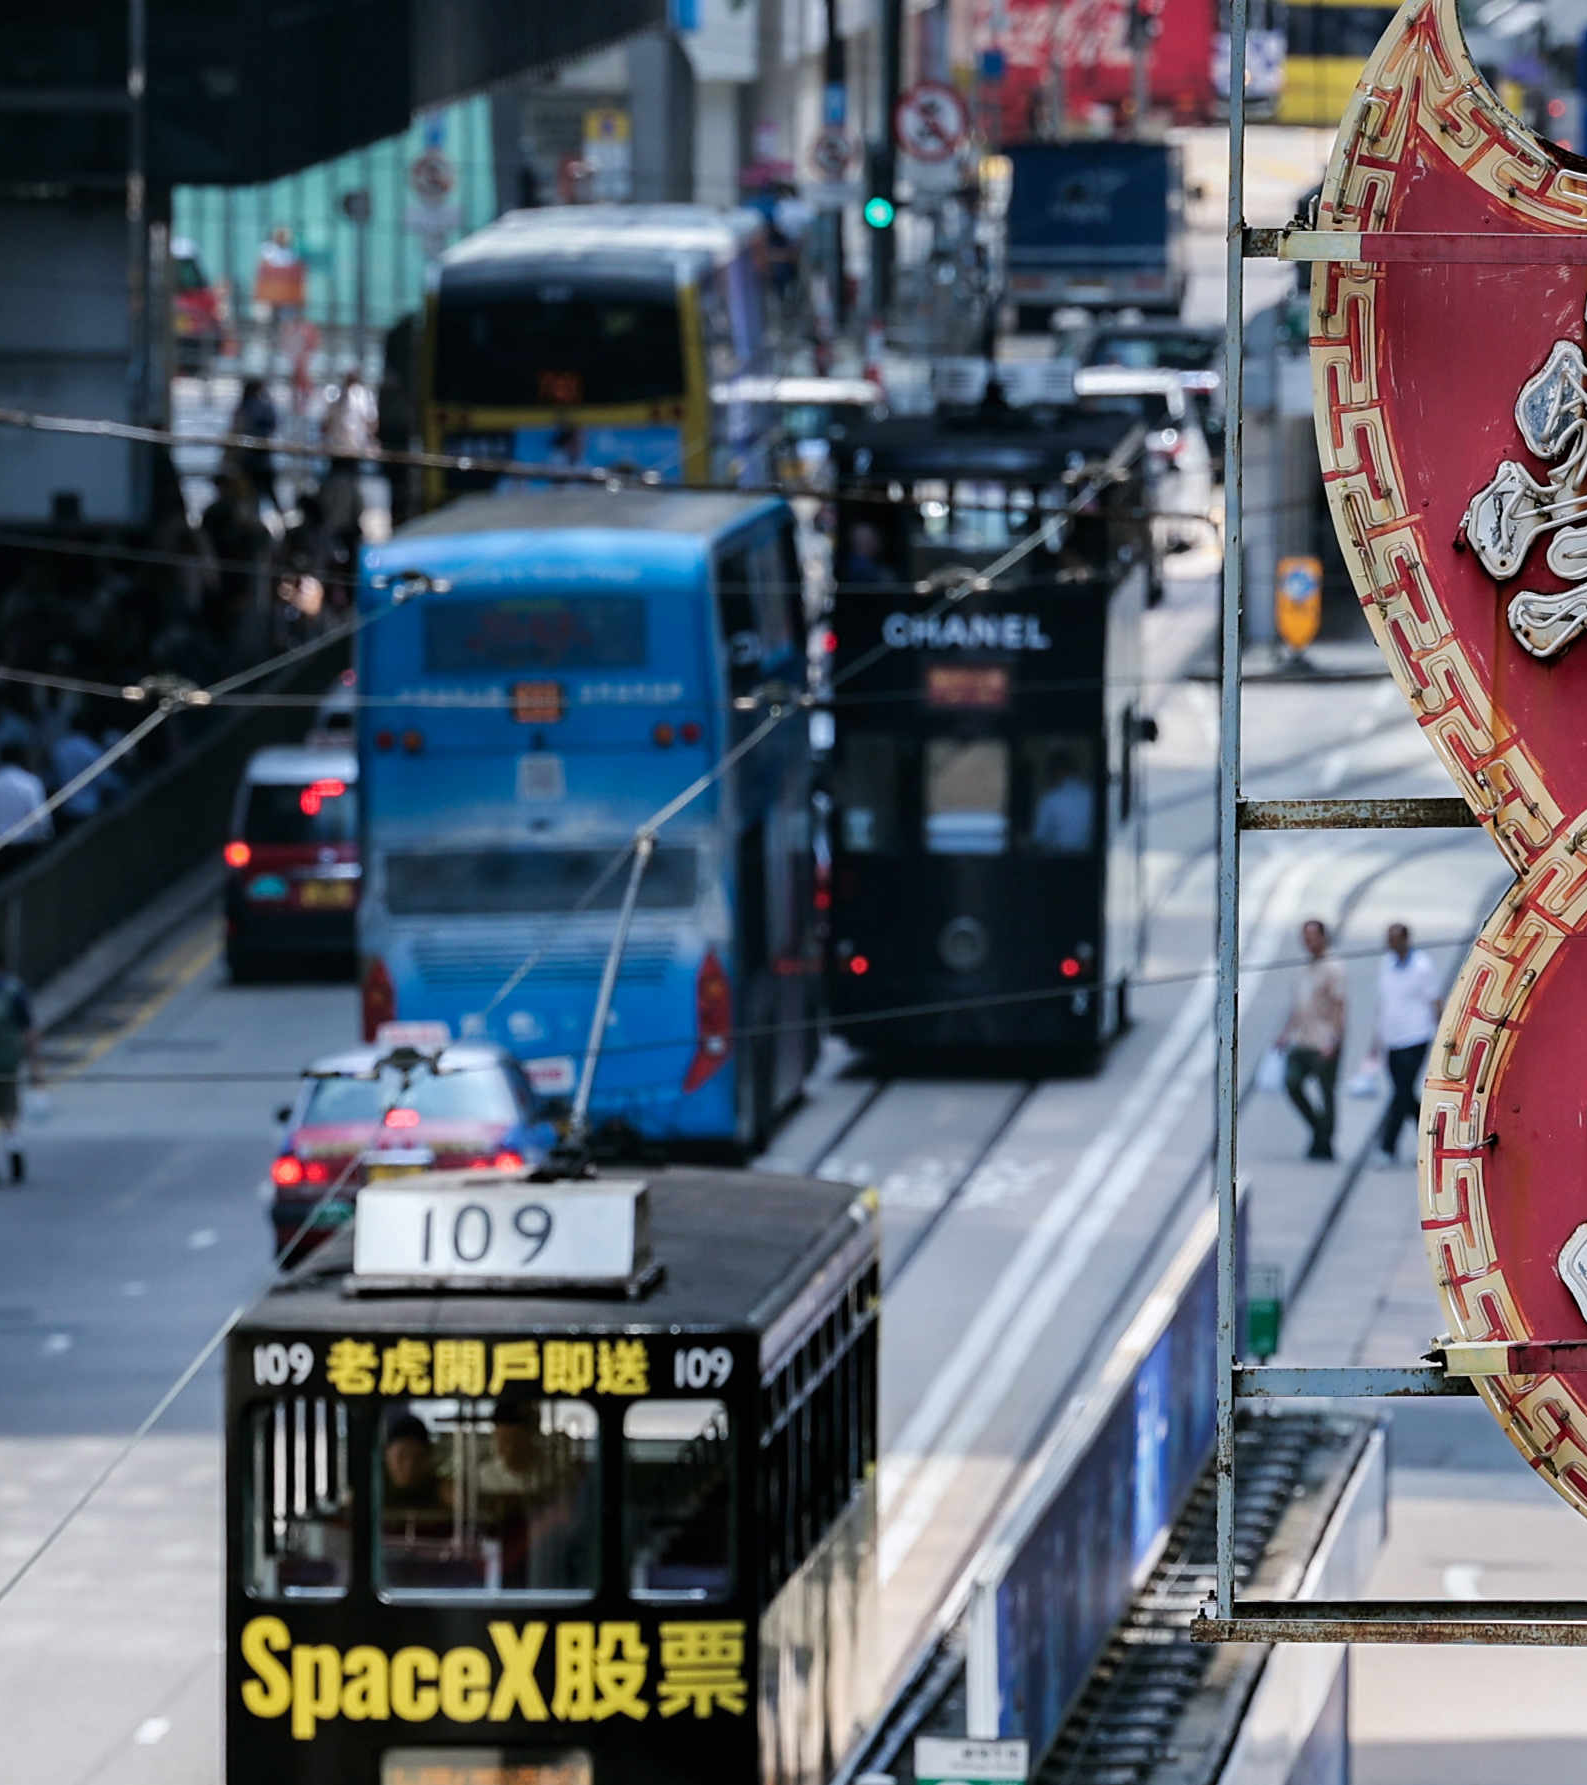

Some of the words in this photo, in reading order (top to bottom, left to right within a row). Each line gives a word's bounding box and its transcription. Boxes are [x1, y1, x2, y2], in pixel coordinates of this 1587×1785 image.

[883, 613, 1051, 651] CHANEL
[421, 1203, 554, 1264] 109
[253, 1343, 314, 1386] 109
[326, 1338, 649, 1396] 老虎開戶即送
[673, 1347, 733, 1388] 109
[240, 1615, 748, 1740] SpaceX股票
